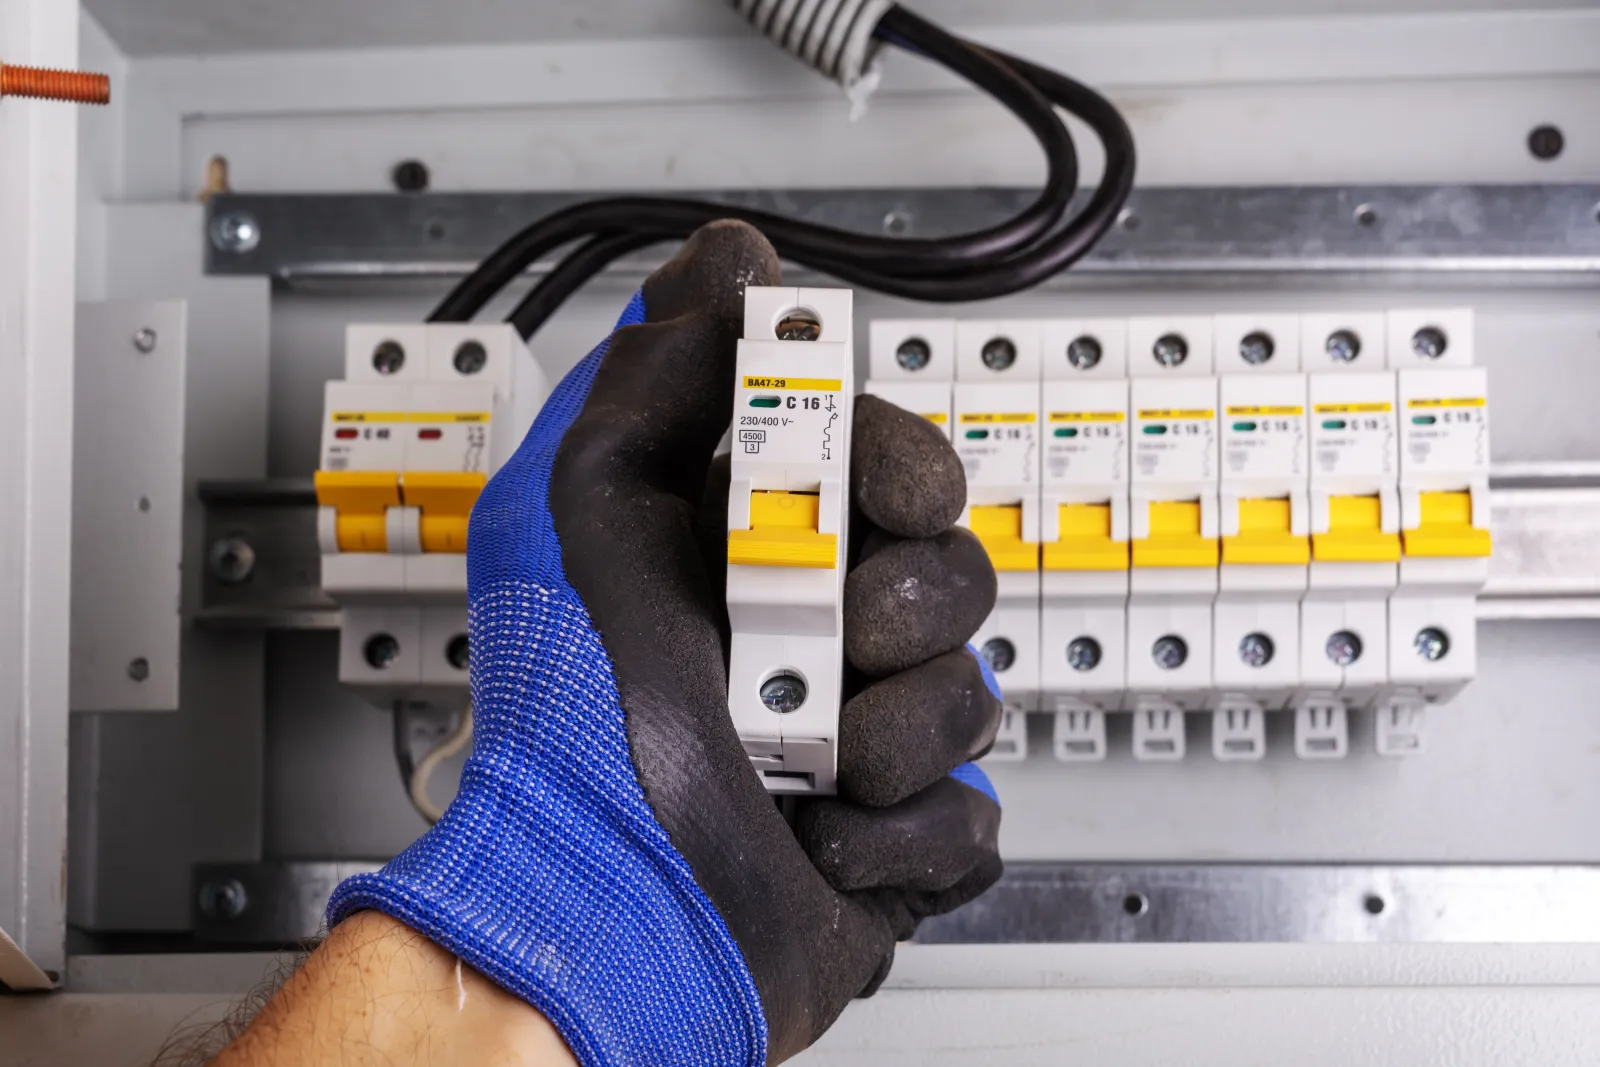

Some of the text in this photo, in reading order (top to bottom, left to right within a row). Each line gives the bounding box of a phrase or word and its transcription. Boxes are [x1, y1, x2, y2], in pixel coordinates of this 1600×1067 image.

[748, 378, 786, 388] BA47-29
[786, 396, 820, 410] C 16
[740, 416, 779, 426] 230/400
[742, 432, 763, 441] 4500
[749, 443, 755, 451] 3
